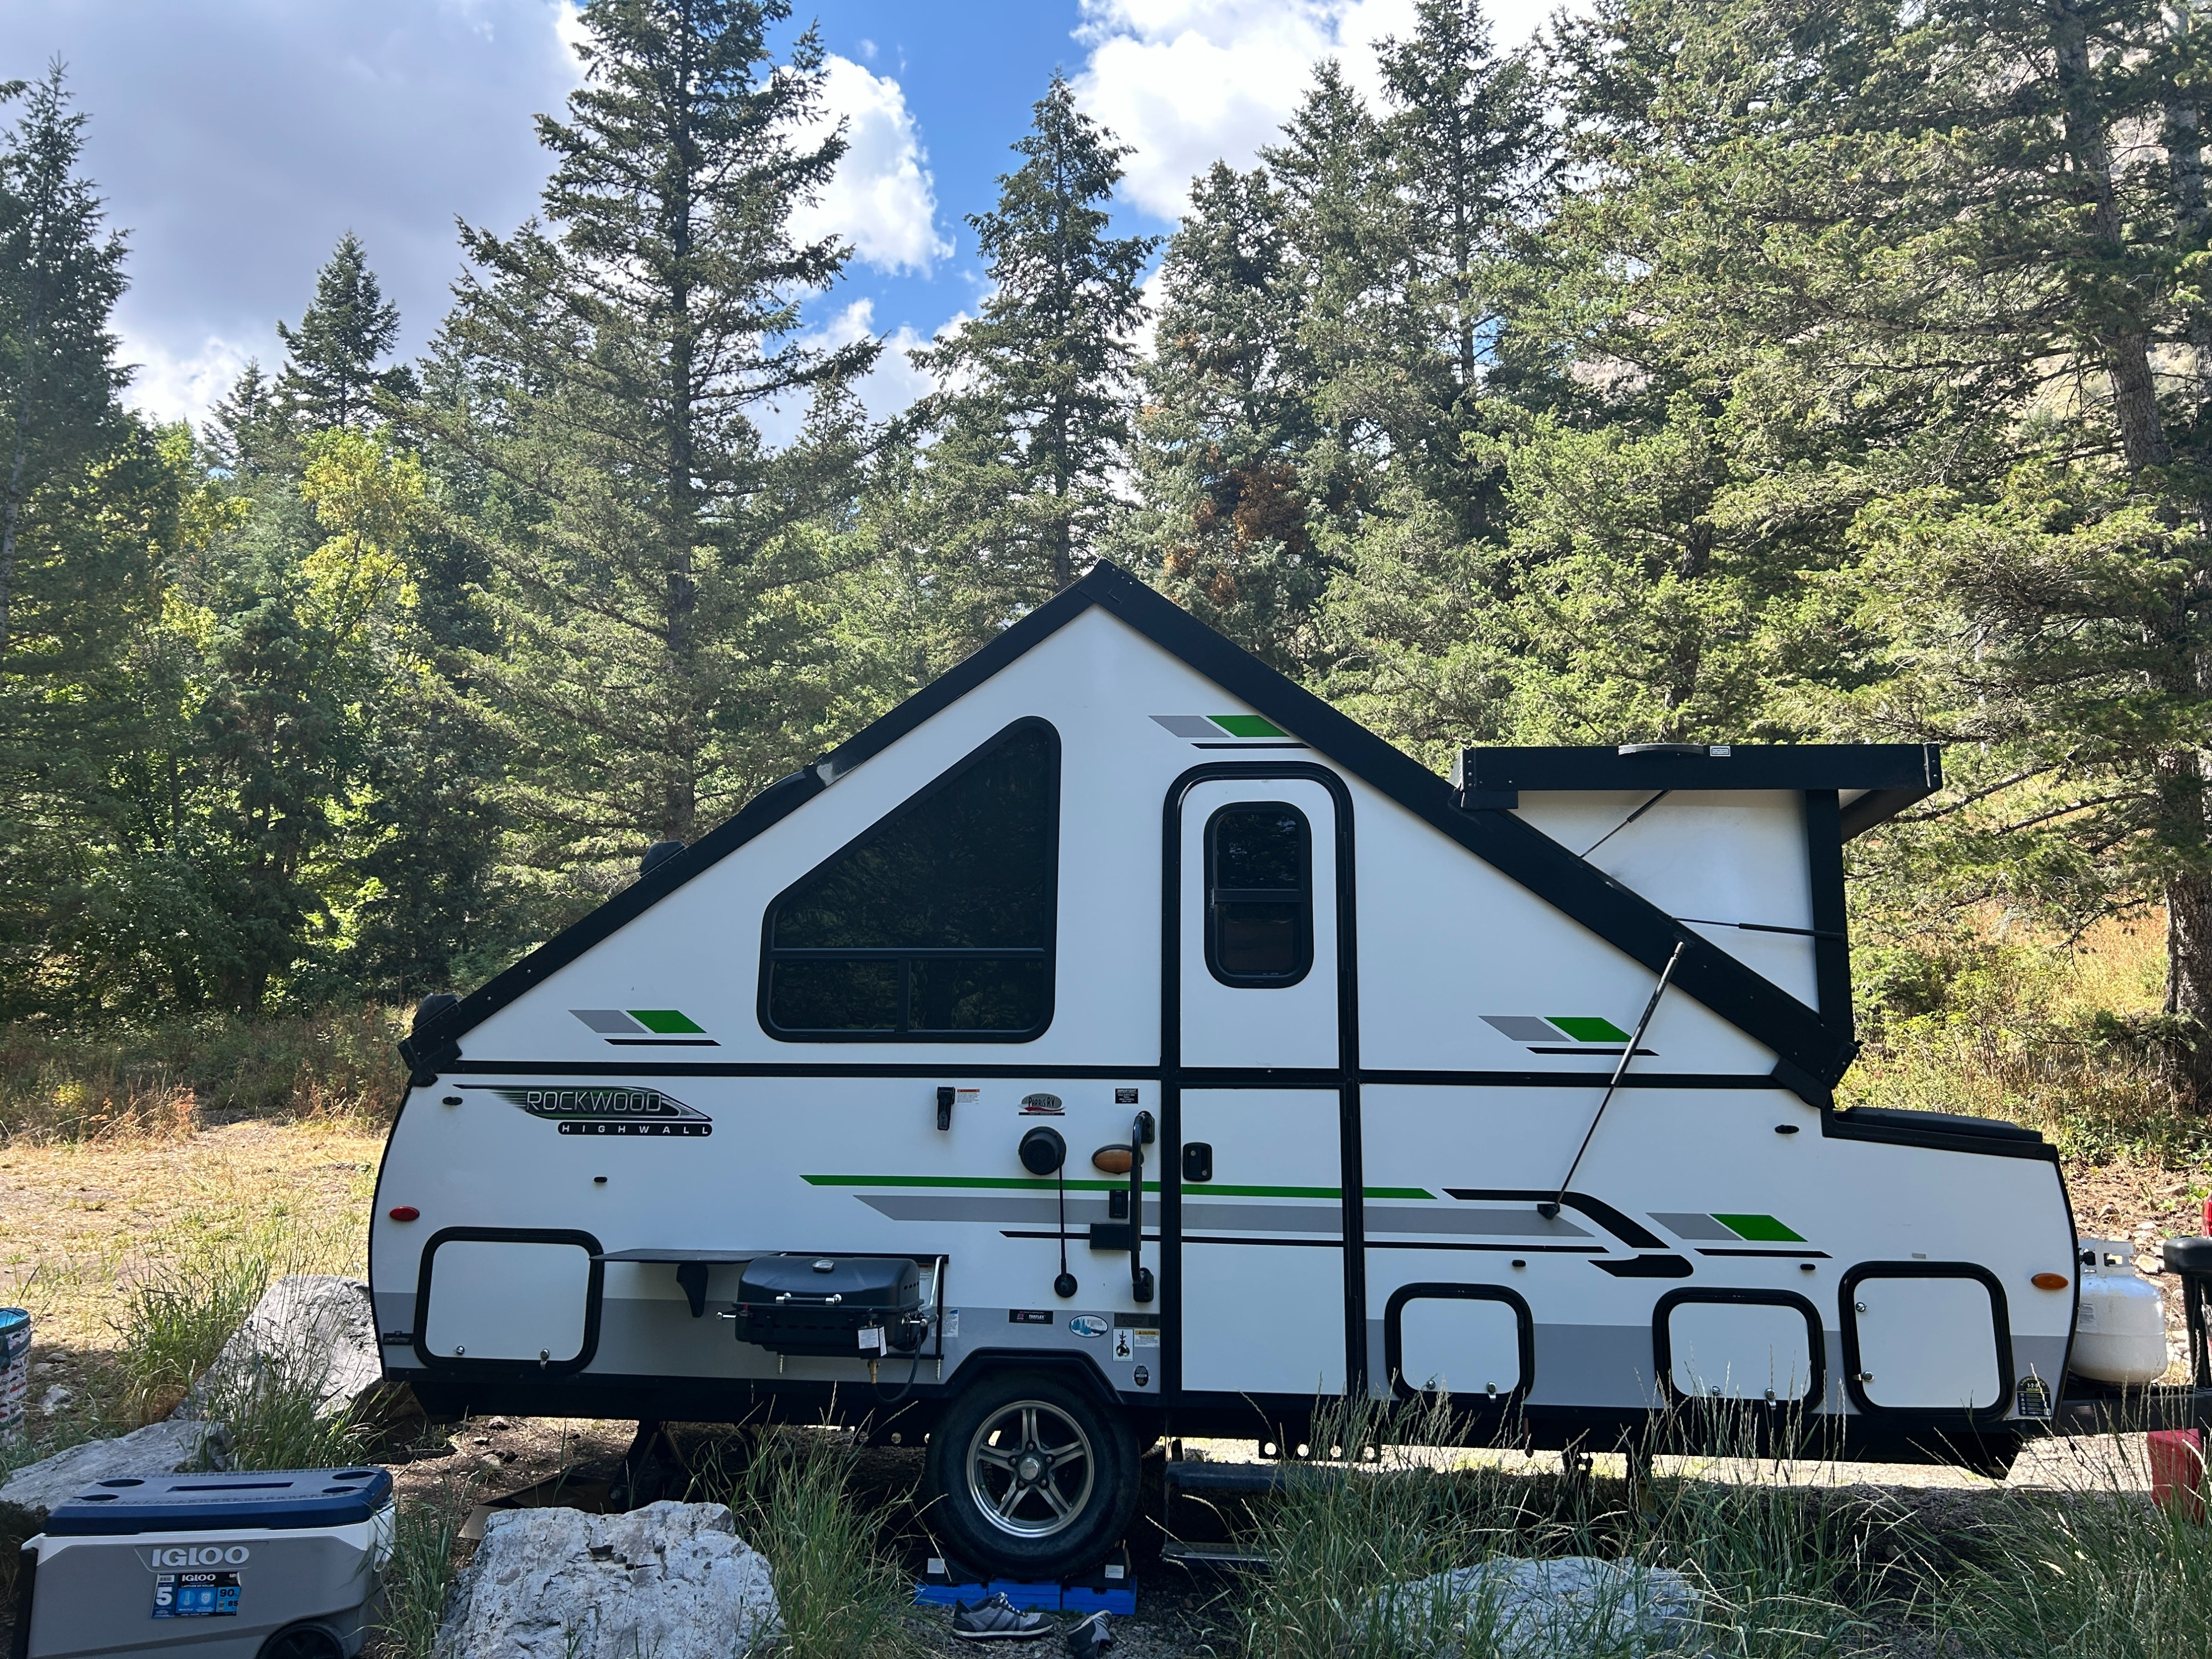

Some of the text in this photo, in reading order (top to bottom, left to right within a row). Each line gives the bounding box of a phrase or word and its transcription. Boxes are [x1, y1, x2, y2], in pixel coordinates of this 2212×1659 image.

[526, 1091, 662, 1112] ROCKWOOD
[1028, 1097, 1055, 1107] PARRIS RV
[562, 1125, 708, 1134] HIGHWALL
[152, 1546, 249, 1567] IGLOO
[155, 1587, 173, 1606] 5
[220, 1589, 235, 1597] 90
